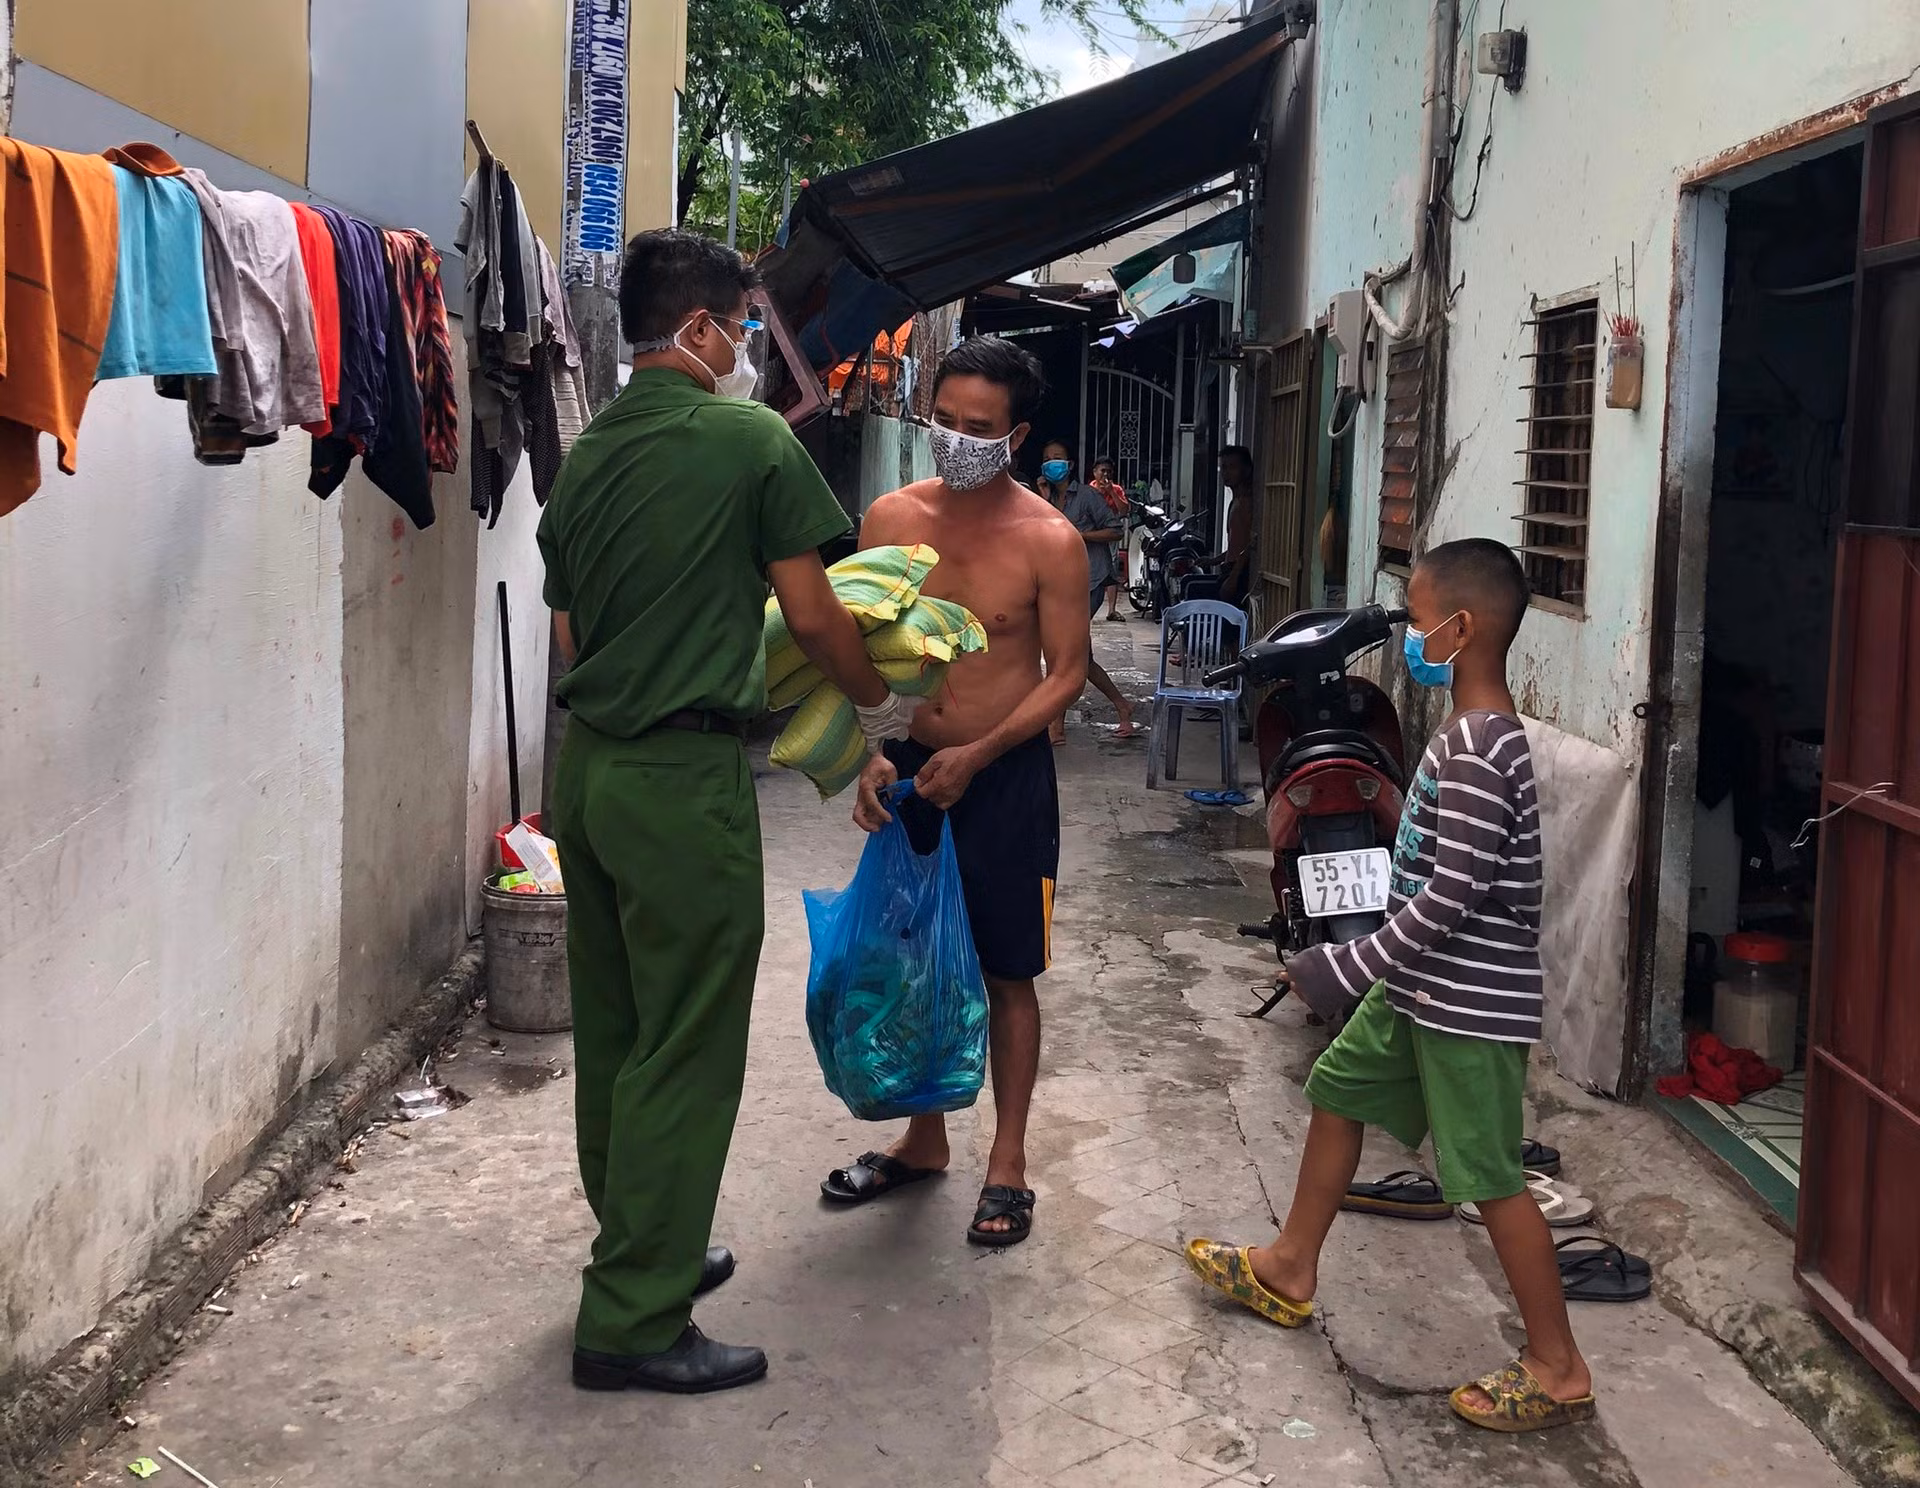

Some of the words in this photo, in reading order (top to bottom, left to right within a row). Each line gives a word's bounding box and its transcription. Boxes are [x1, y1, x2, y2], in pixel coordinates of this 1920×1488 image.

[580, 164, 618, 252] 0934.066.066
[1312, 854, 1378, 883] 55-Y4
[1316, 881, 1382, 911] 7204
